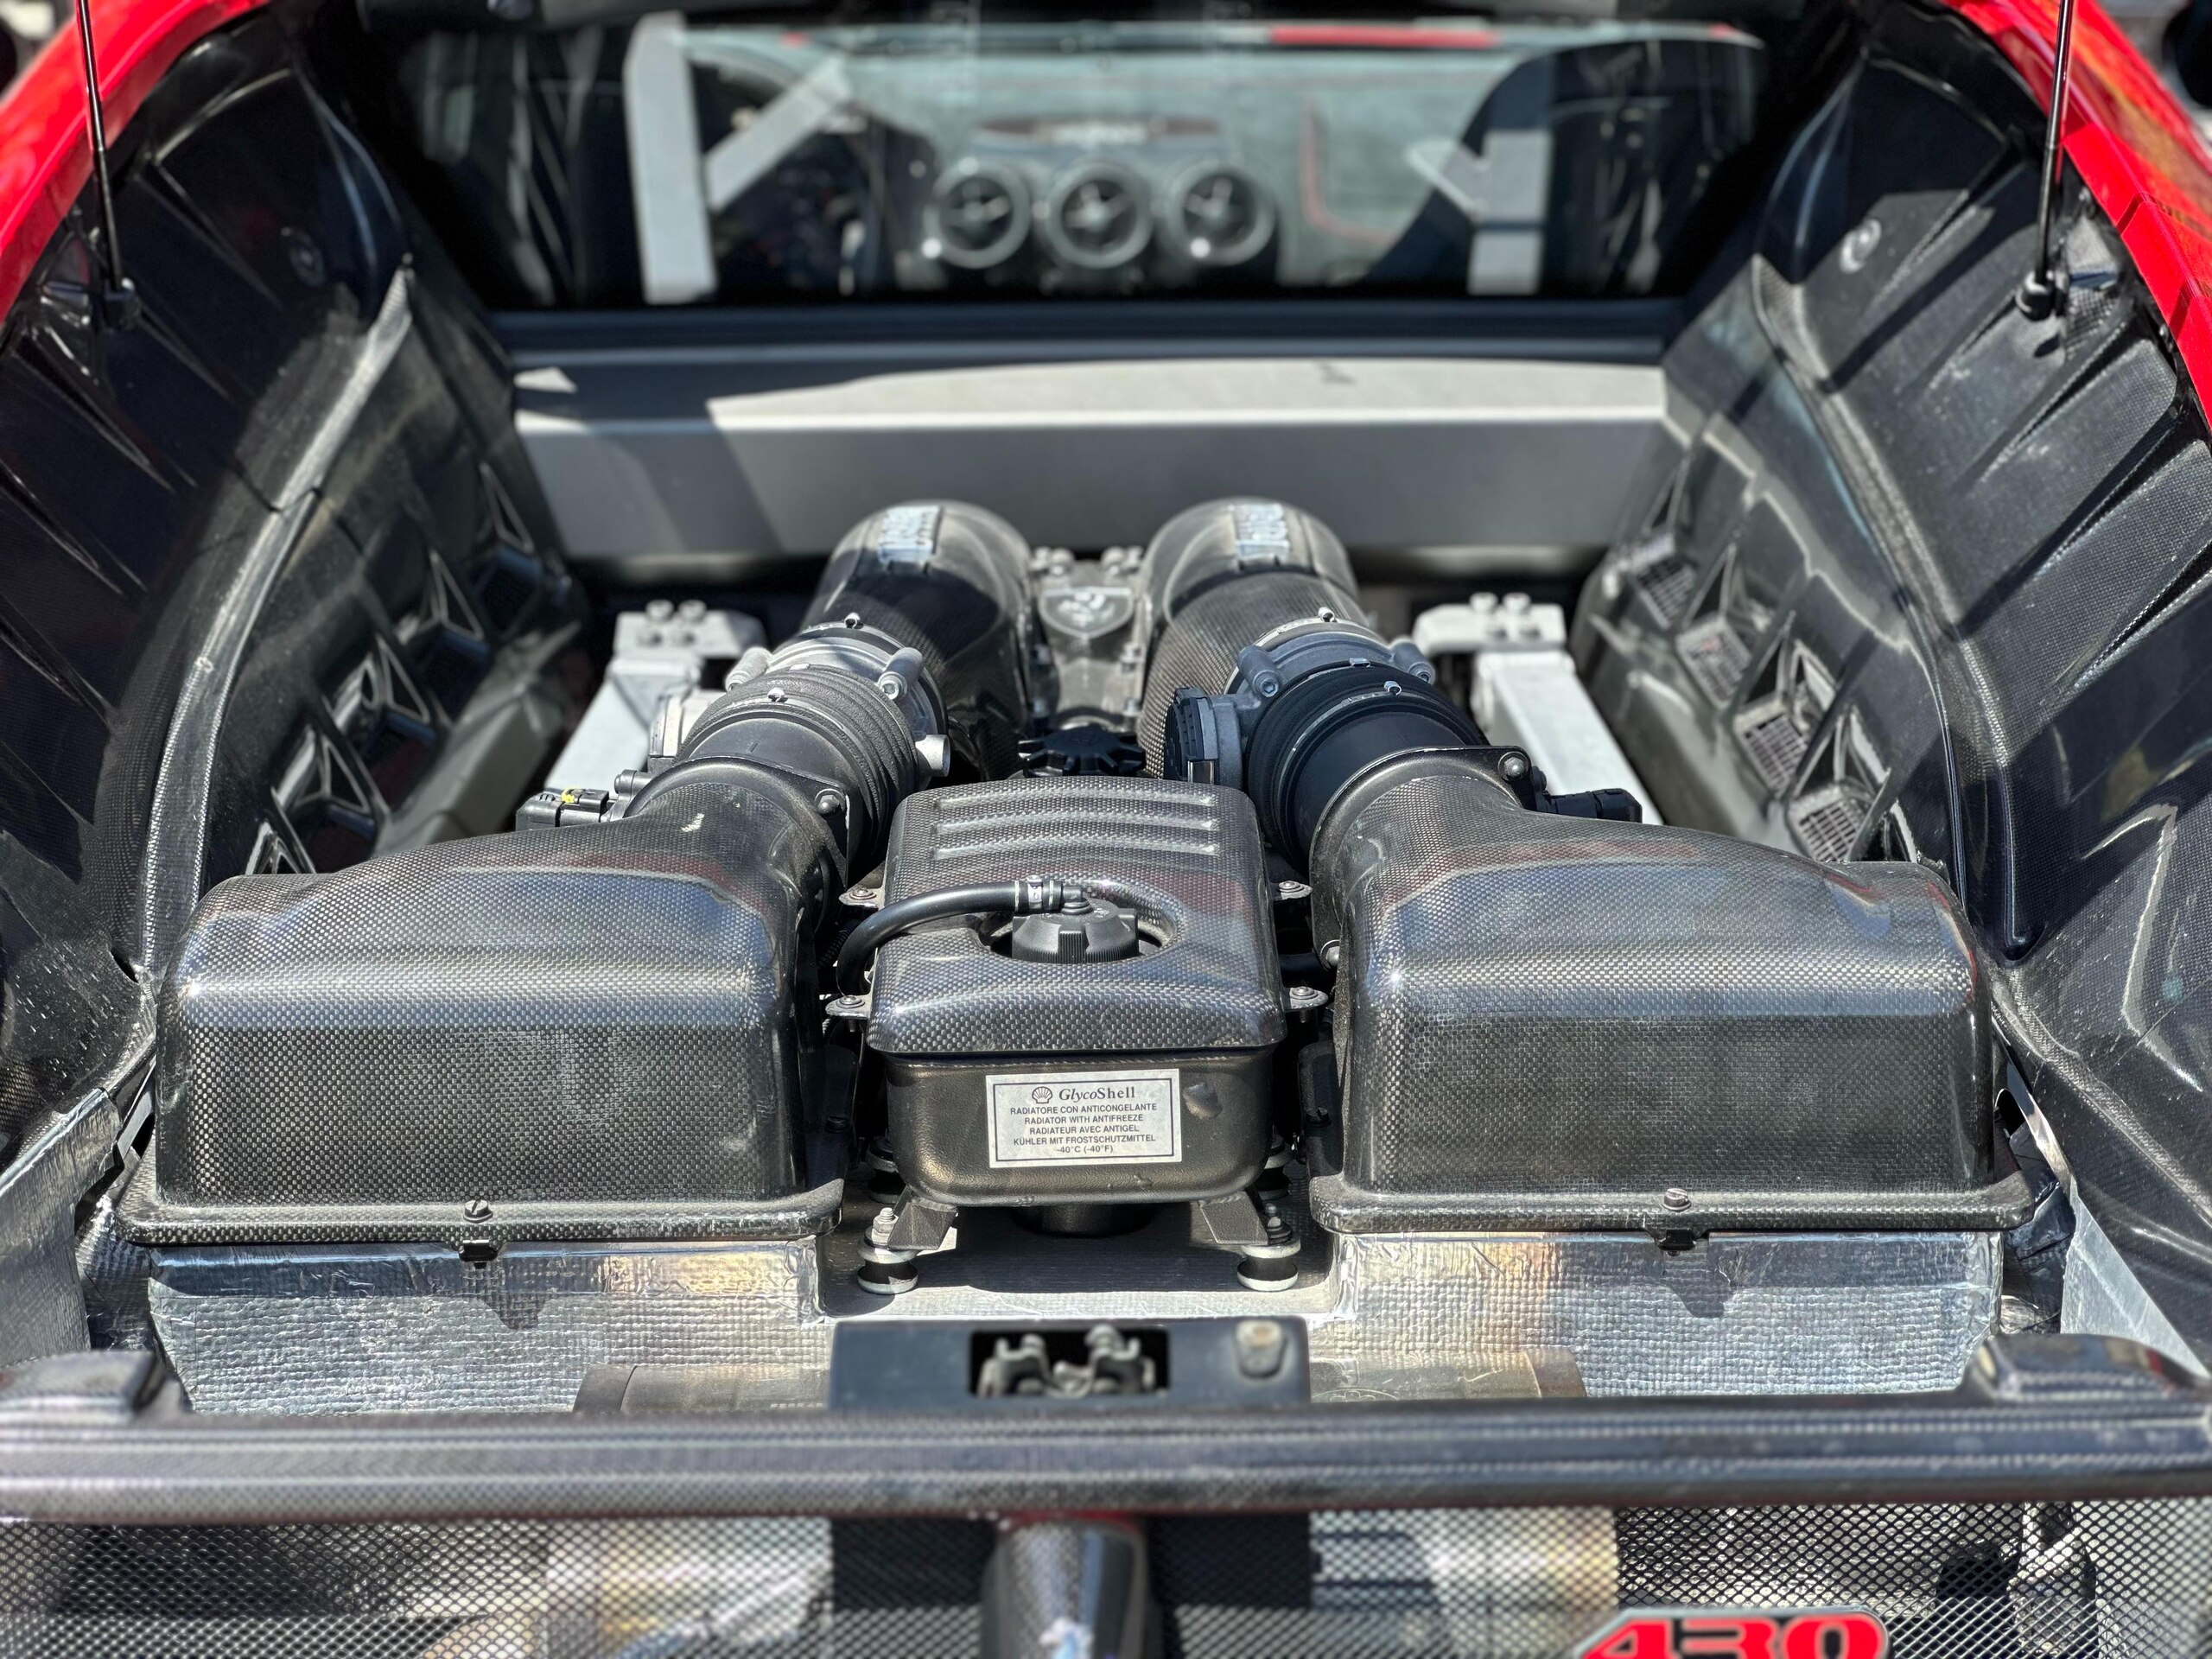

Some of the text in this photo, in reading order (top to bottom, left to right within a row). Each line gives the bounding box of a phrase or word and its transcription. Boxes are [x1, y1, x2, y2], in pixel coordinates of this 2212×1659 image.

[1058, 1086, 1135, 1103] GlycoShell
[1010, 1103, 1157, 1115] RADIATORE CON ANTICONGELANTE
[1092, 1114, 1144, 1122] ANTIFREEZE
[1029, 1126, 1077, 1135] RADIATEUR
[1103, 1124, 1140, 1133] ANTIGEL
[1014, 1136, 1047, 1146] KÜHLER
[1065, 1134, 1156, 1144] FROSTSCHUTZMITTEL
[1056, 1144, 1114, 1154] -40°C (-40°F)
[1580, 1614, 1885, 1659] 430
